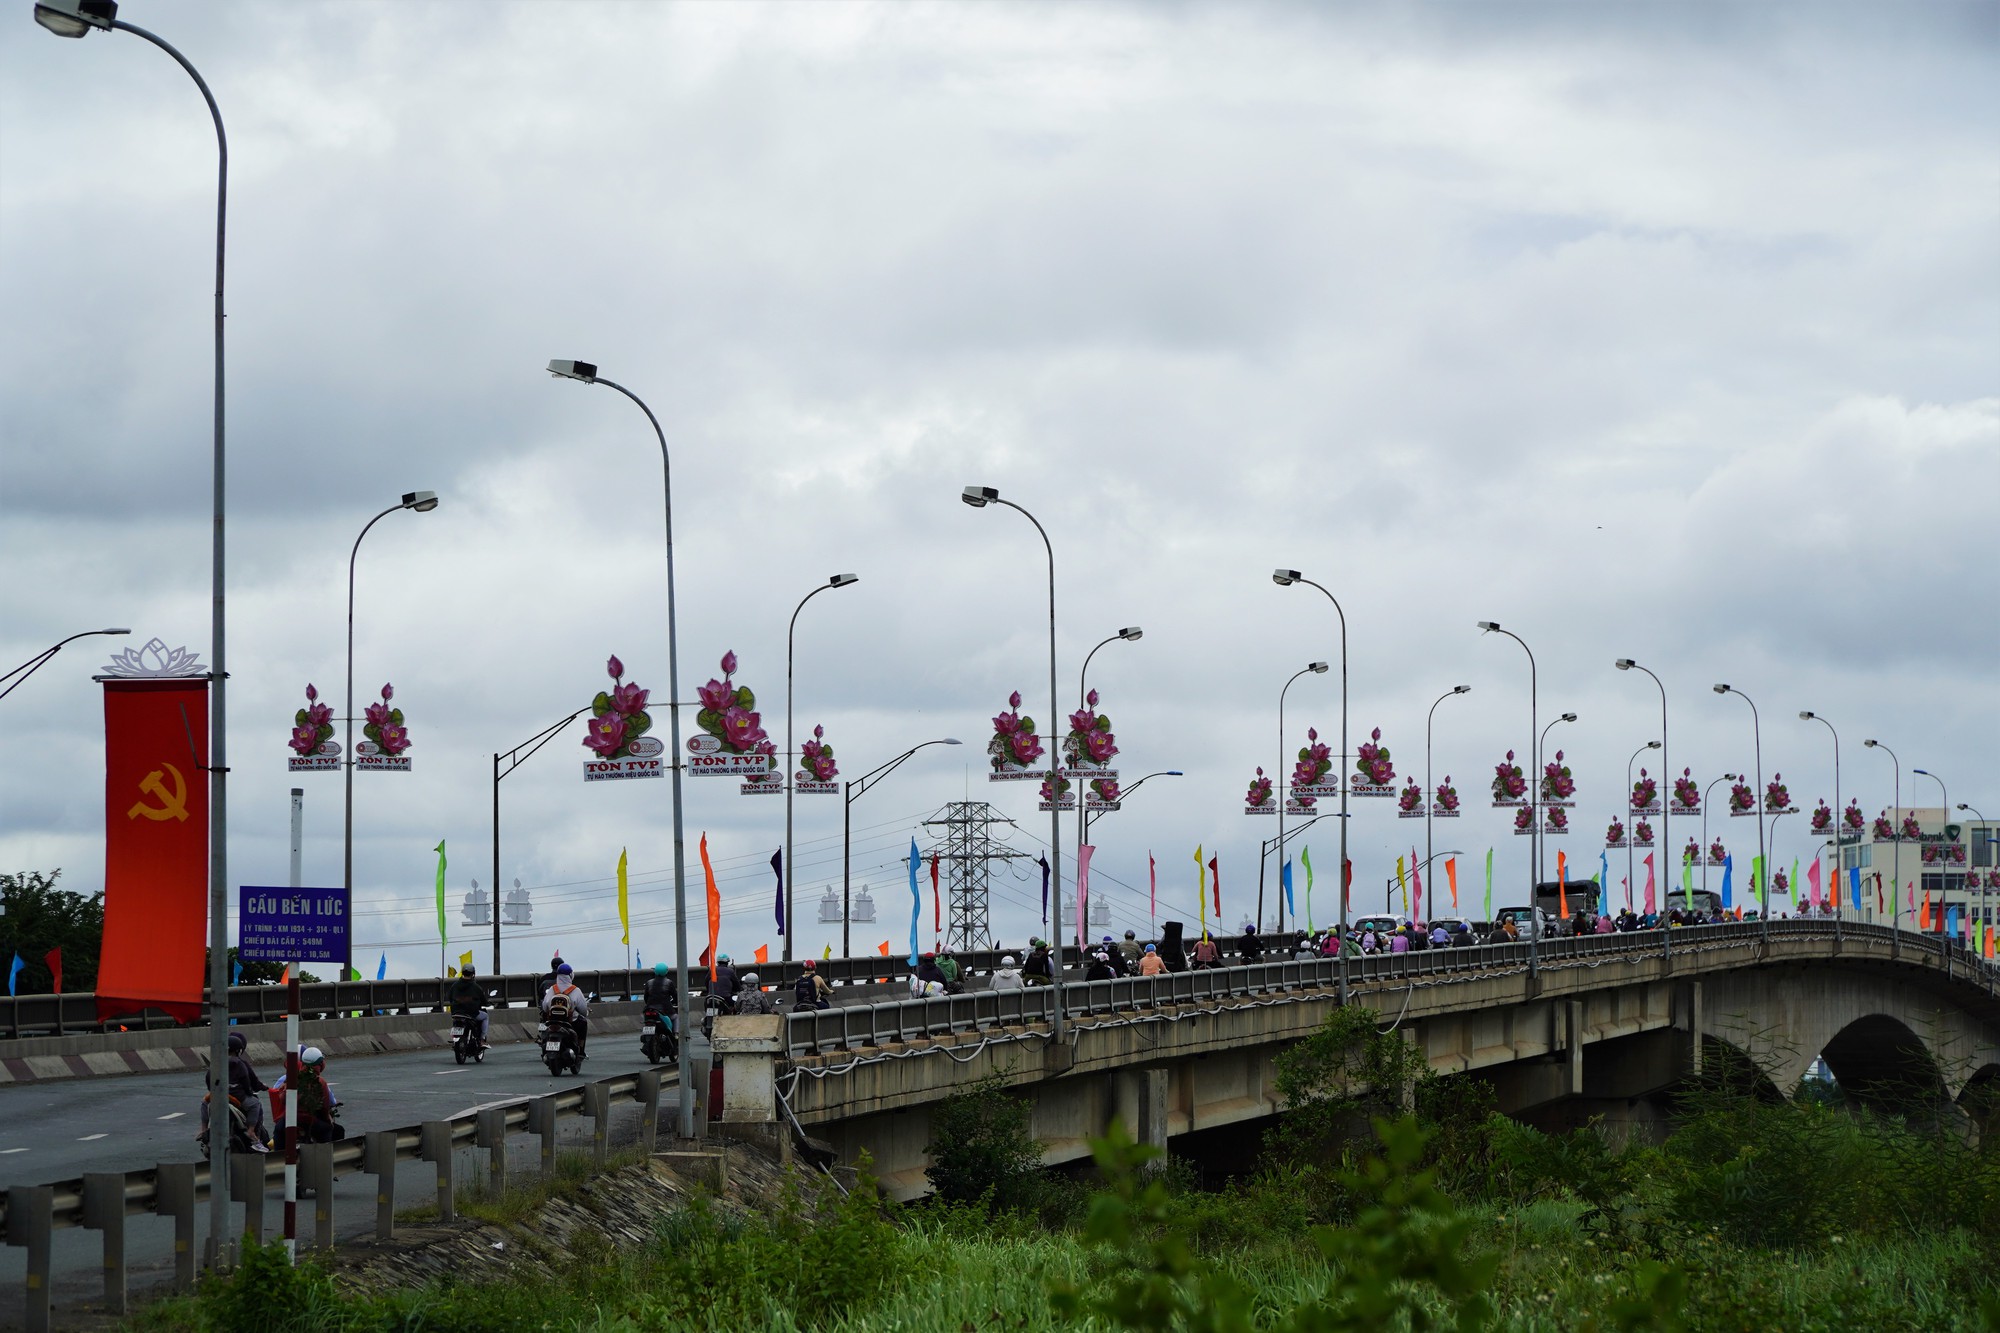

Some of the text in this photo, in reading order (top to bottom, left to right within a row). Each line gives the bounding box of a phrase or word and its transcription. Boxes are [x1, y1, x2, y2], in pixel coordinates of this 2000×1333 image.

[291, 757, 313, 765] TÔN
[587, 760, 659, 772] TÔN TVP
[692, 755, 765, 766] TÔN TVP
[248, 893, 342, 916] CẦU BẾN LỨC
[302, 938, 322, 946] 549M
